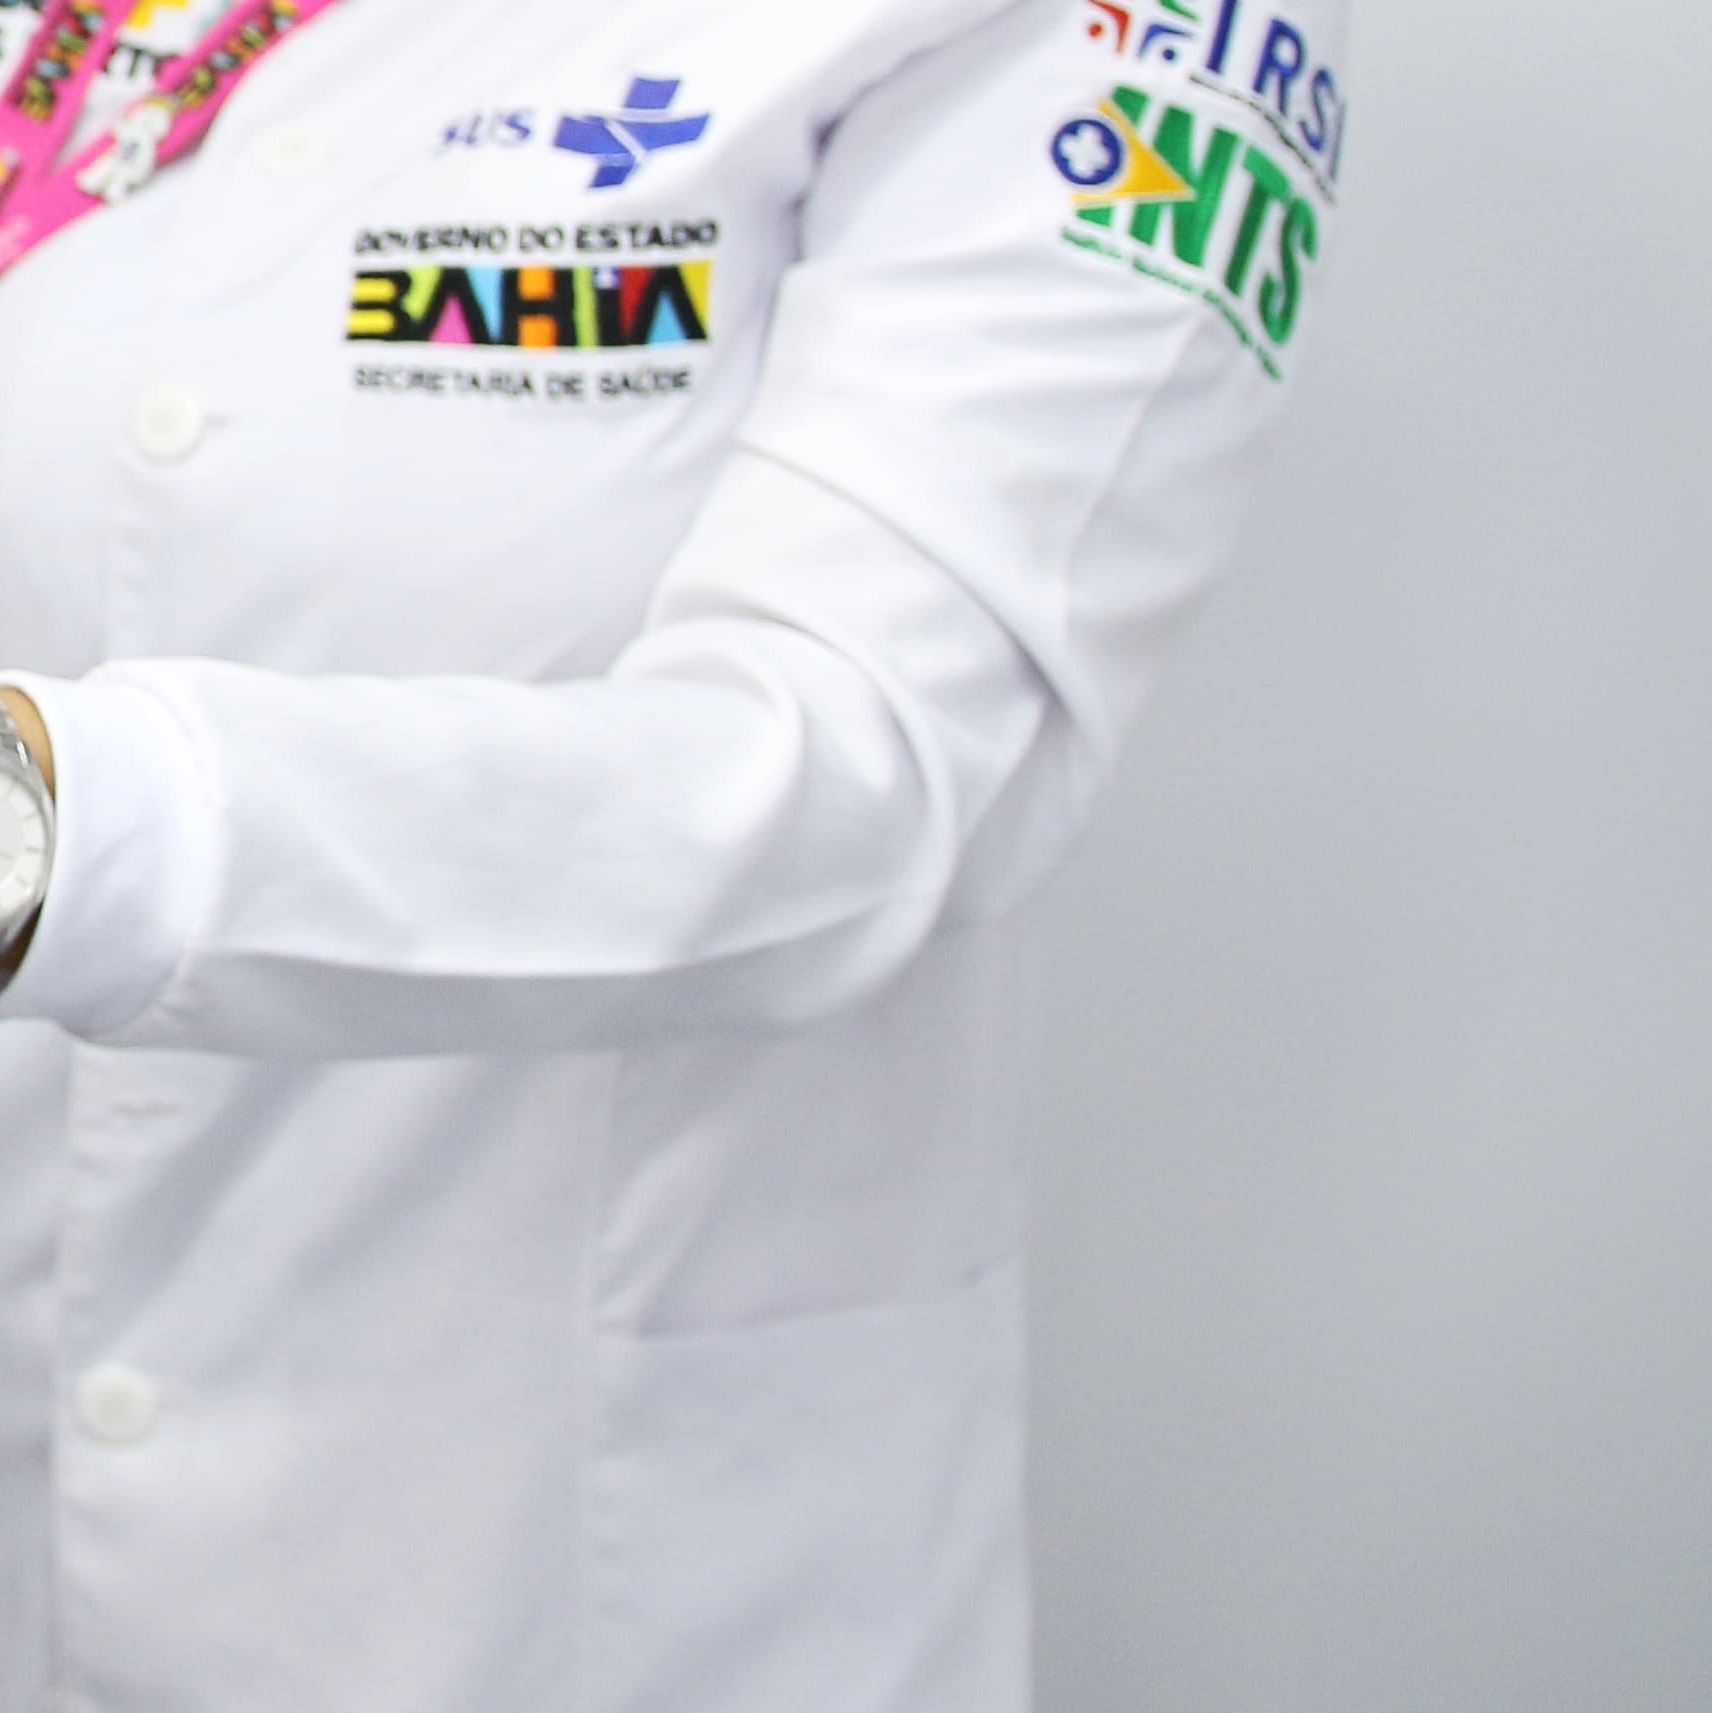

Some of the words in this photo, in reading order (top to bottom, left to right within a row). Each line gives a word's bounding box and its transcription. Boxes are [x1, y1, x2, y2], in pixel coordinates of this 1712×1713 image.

[434, 107, 535, 156] SUS
[354, 226, 508, 255] GOVERNO
[519, 226, 564, 252] DO
[575, 221, 719, 252] ESTADO
[345, 261, 712, 349] BAHIA
[355, 366, 535, 397] SECRETARIA
[546, 372, 584, 397] DE
